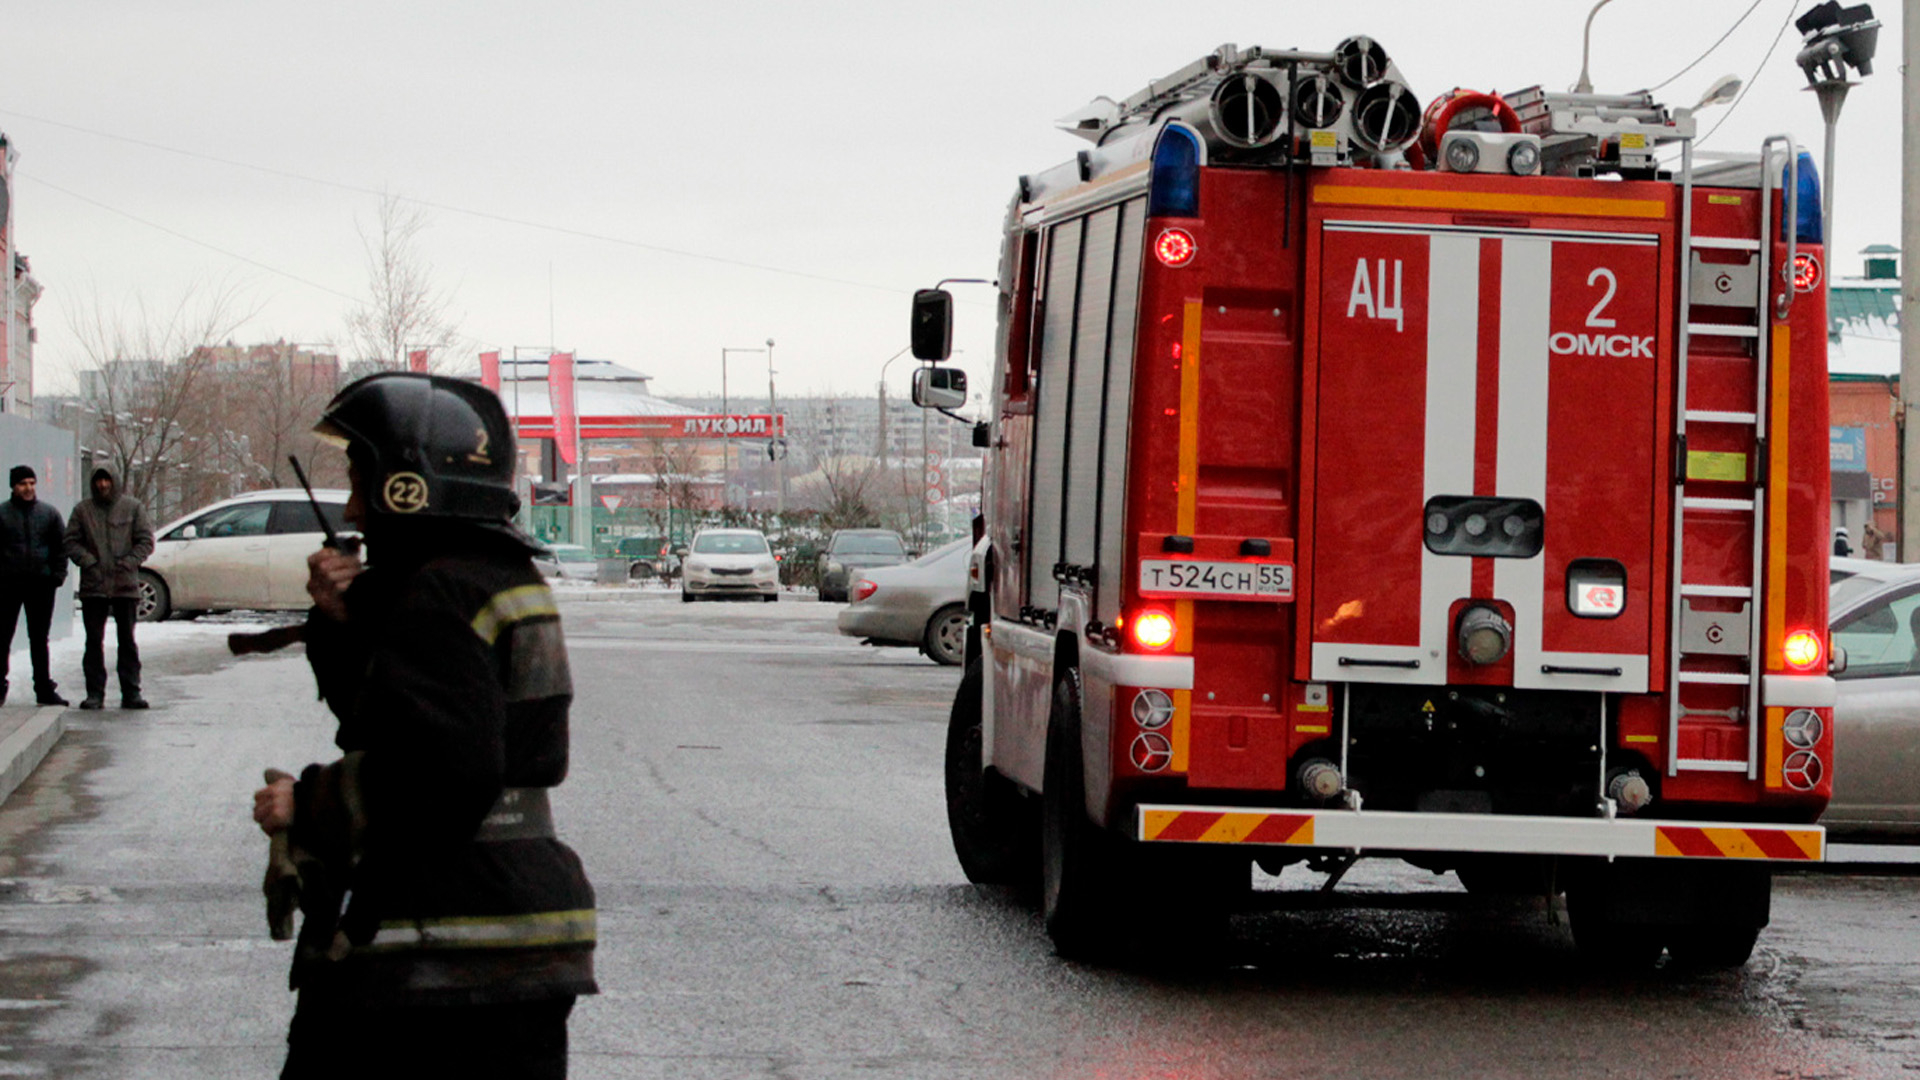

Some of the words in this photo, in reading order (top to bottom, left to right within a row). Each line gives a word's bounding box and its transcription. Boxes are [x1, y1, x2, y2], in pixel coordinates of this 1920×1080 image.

[1347, 258, 1403, 332] АЦ
[1585, 267, 1617, 327] 2
[1549, 332, 1655, 358] ОМСК
[683, 414, 766, 433] ЛУКОЙЛ
[476, 428, 489, 455] 2
[392, 481, 420, 504] 22
[1259, 567, 1284, 586] 55
